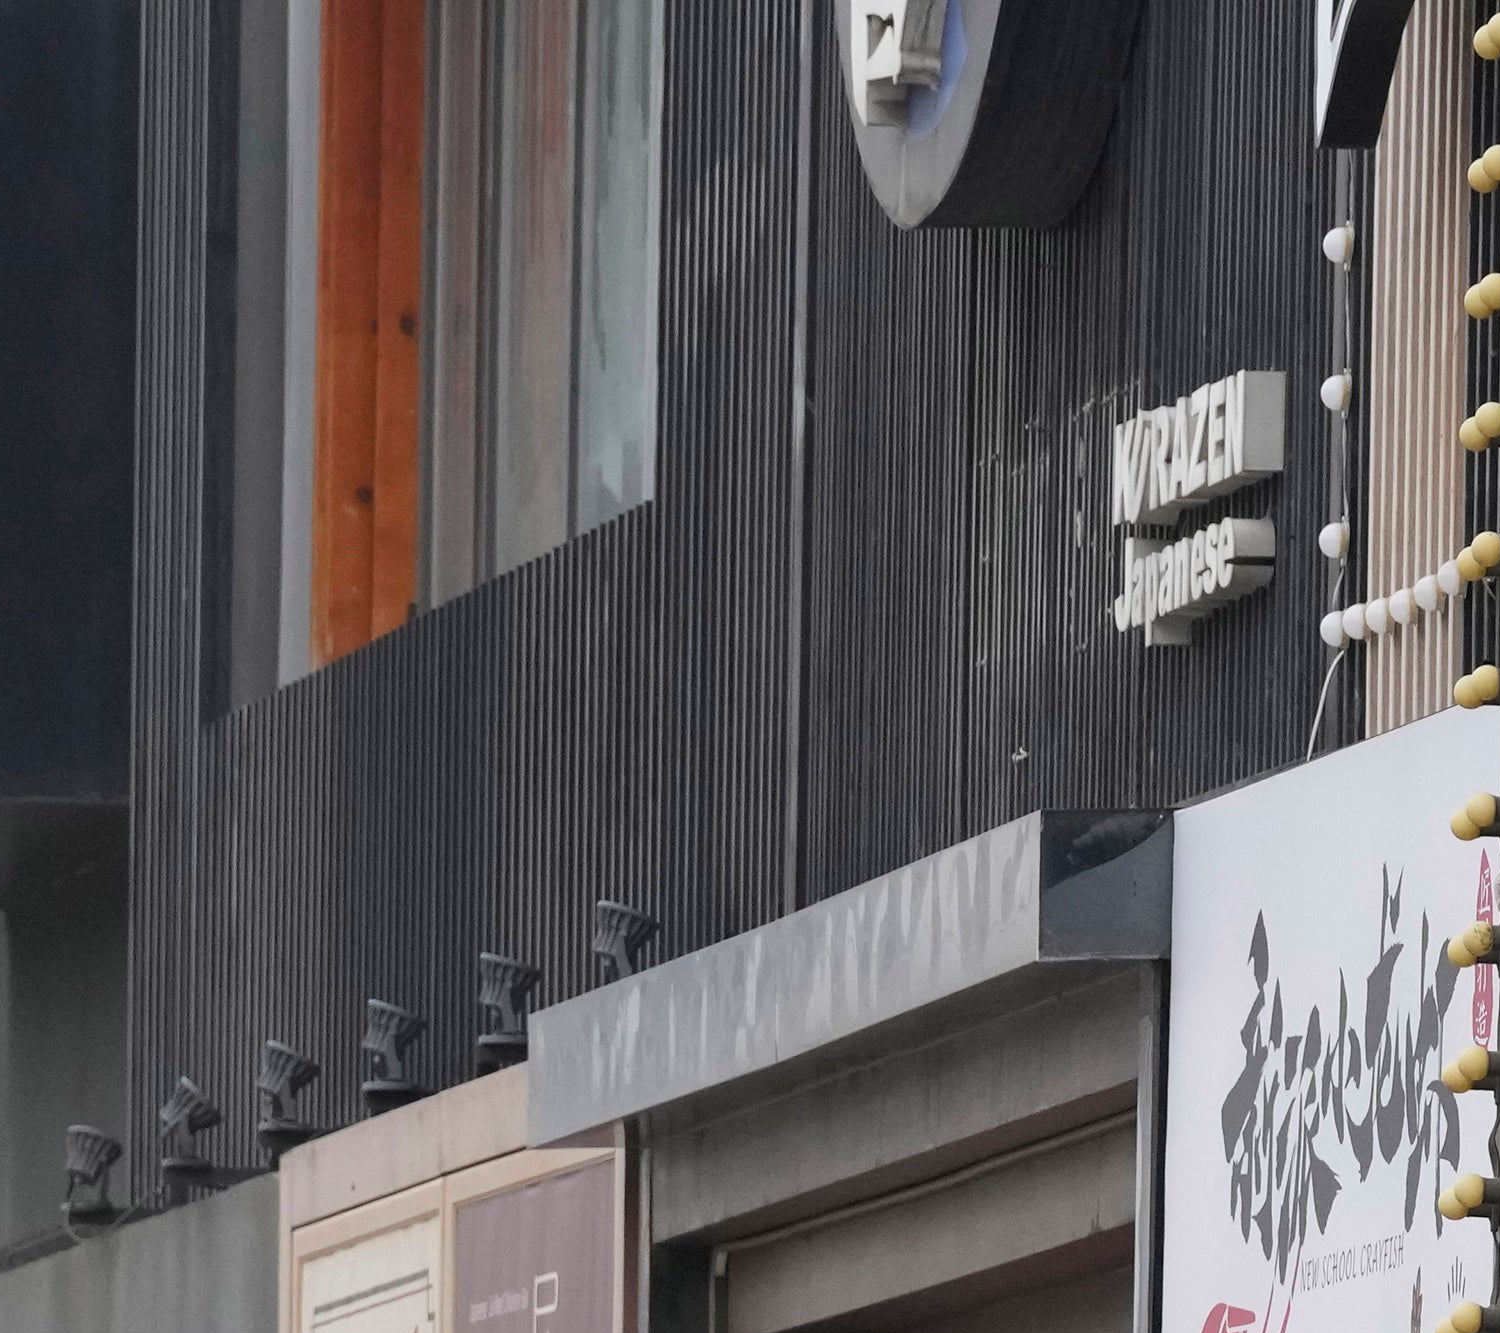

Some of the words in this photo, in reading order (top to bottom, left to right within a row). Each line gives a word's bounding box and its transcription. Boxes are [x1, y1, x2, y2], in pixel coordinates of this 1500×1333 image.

[1115, 517, 1235, 647] Japanese
[1475, 867, 1491, 1045] 匠打造
[1301, 1257, 1320, 1293] NEW
[1321, 1245, 1358, 1288] SCHOOL
[1360, 1231, 1405, 1276] CRAYFISH
